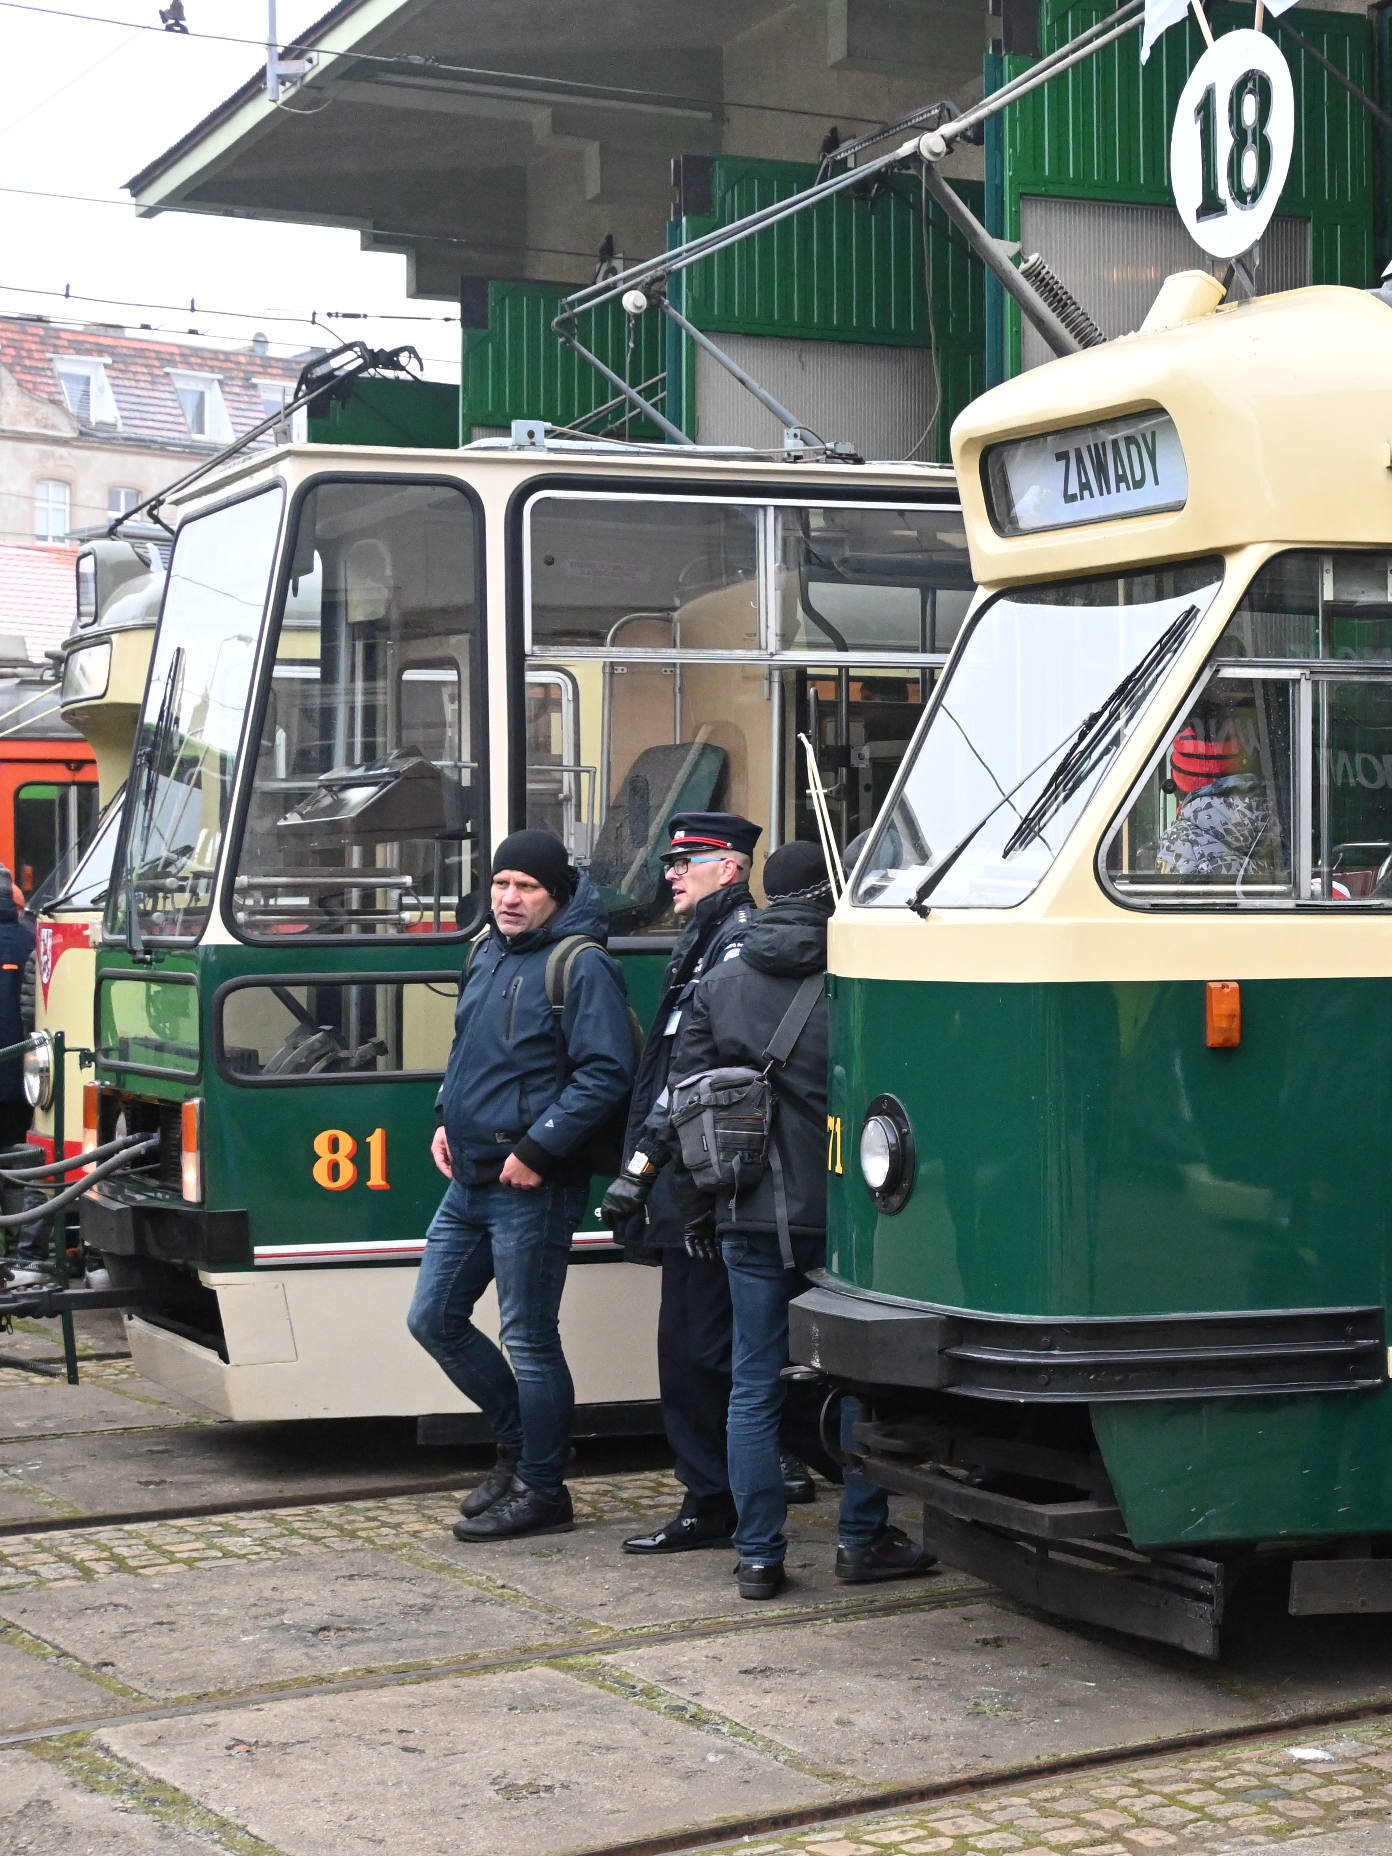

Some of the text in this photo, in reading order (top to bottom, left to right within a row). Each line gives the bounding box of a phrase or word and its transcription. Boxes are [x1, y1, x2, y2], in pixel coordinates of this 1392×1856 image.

[1193, 68, 1274, 224] 18
[1054, 430, 1160, 505] ZAWADY
[312, 1127, 392, 1191] 81
